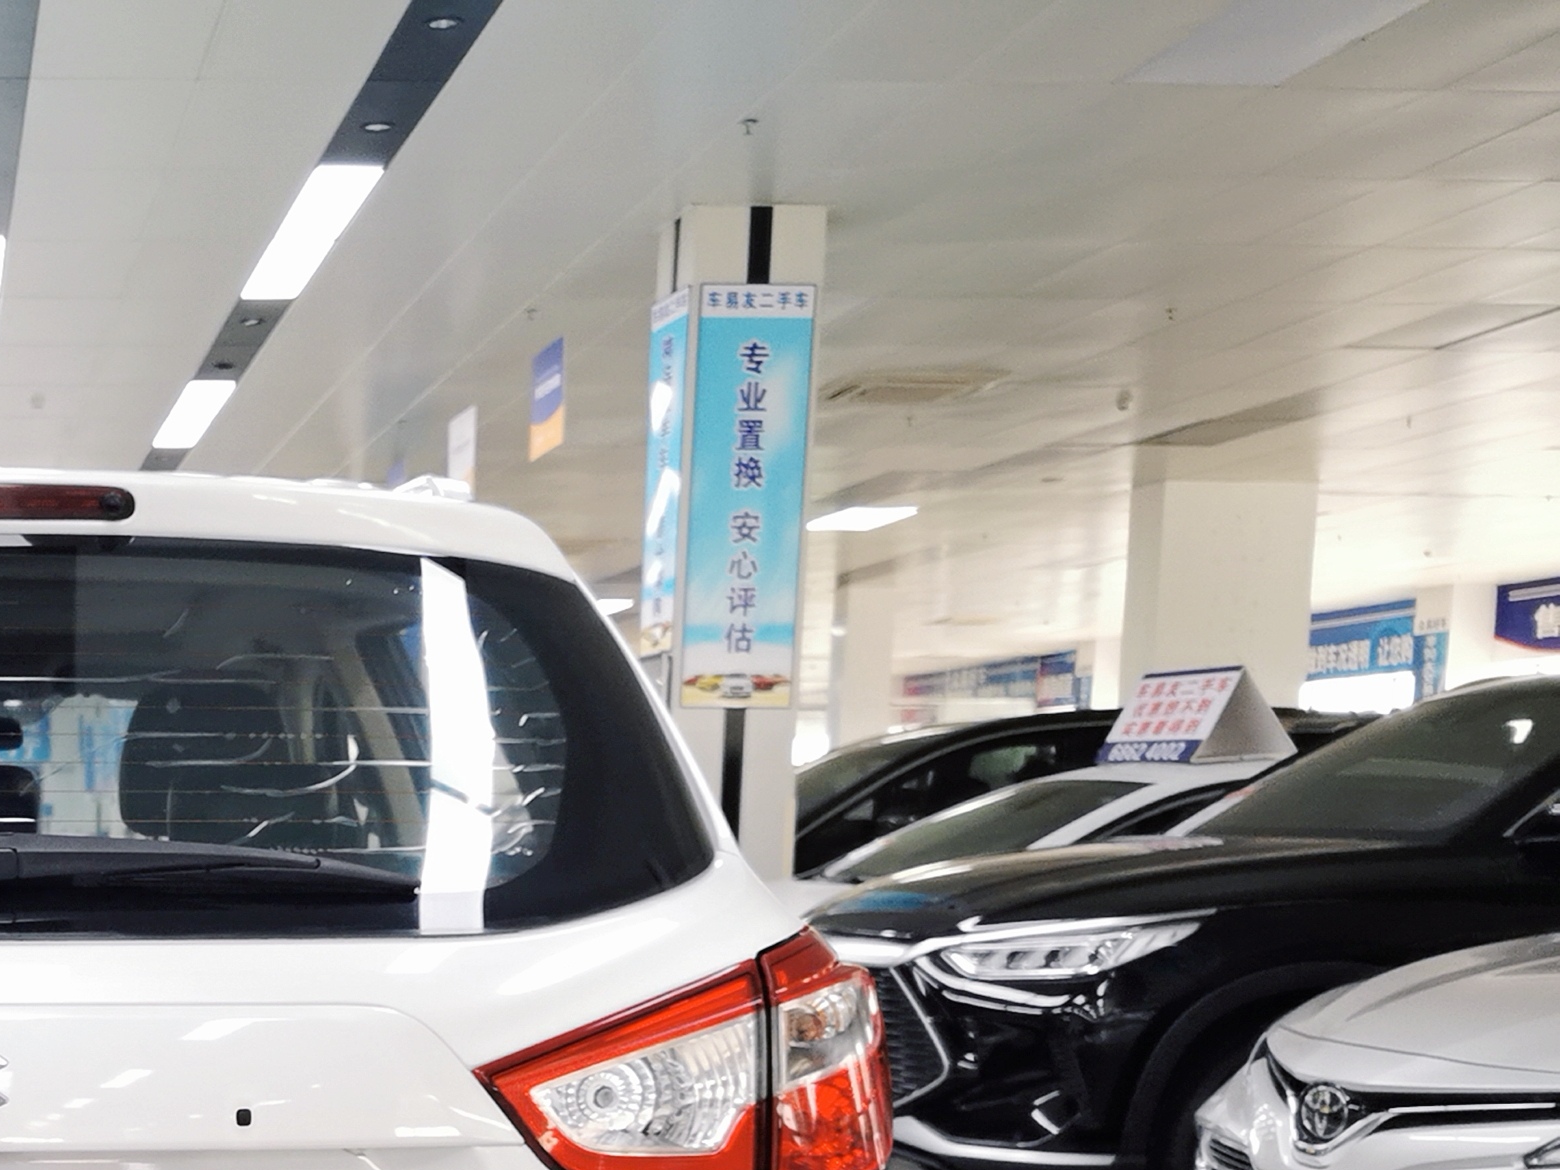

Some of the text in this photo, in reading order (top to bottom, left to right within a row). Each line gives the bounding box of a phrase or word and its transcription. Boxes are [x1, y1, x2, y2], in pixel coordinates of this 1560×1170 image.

[708, 290, 809, 310] 车易友二手车
[724, 341, 770, 654] 专业置换 安心评估
